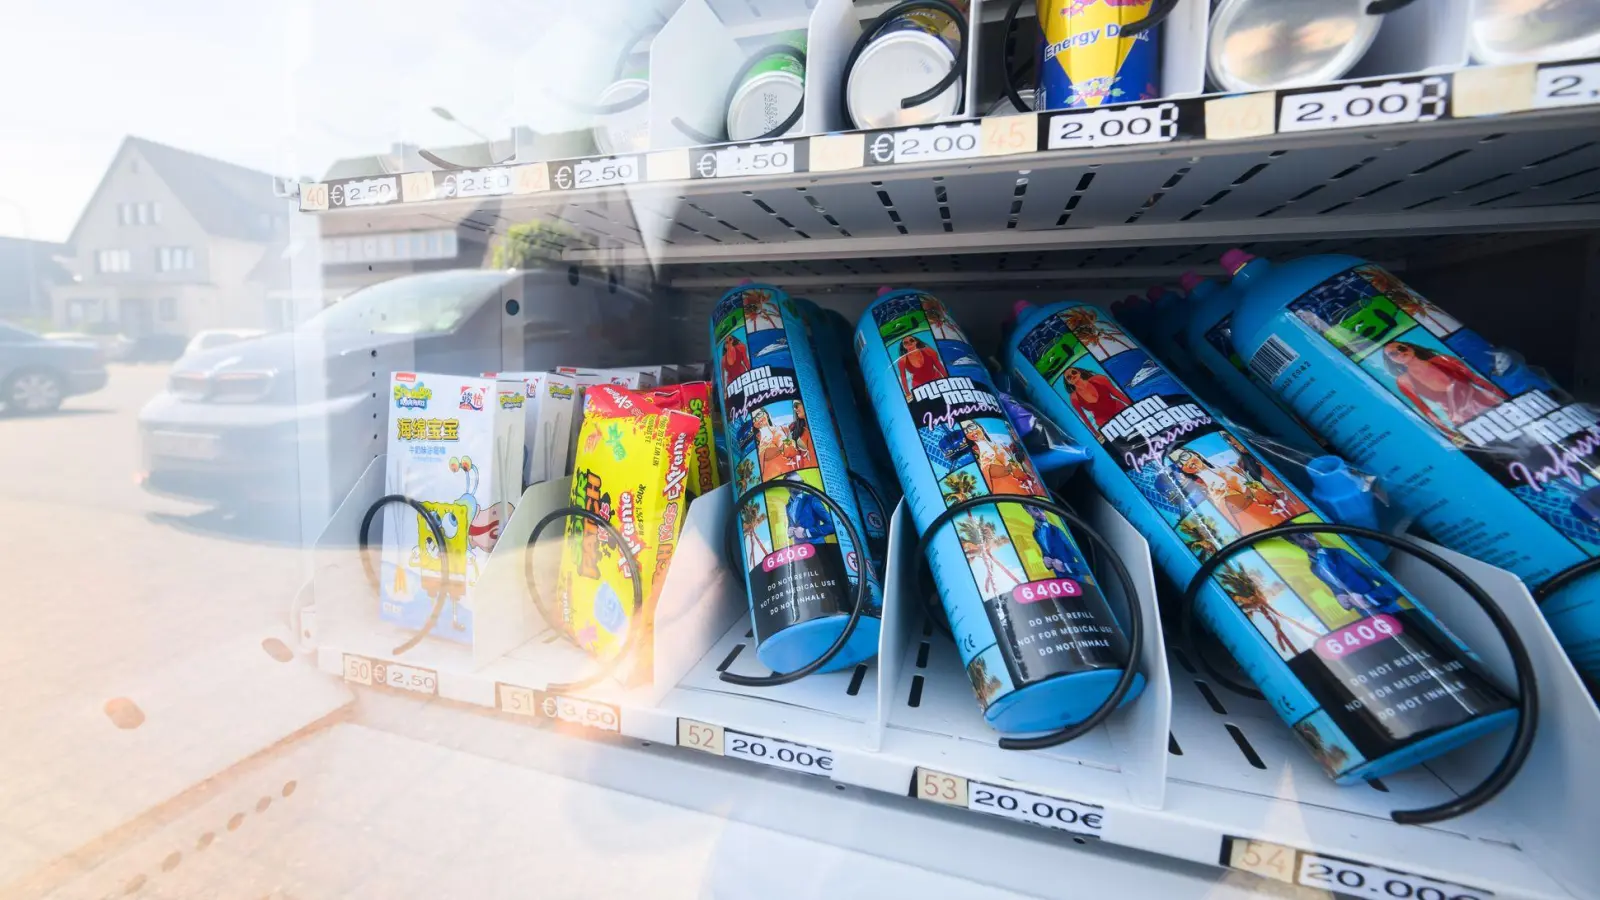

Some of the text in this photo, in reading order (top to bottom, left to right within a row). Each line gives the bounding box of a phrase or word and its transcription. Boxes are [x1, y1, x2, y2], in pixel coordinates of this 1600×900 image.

[1044, 28, 1100, 62] Energy
[1295, 94, 1408, 122] 2,00
[990, 119, 1025, 149] 45
[1060, 117, 1152, 140] 2,00
[901, 134, 976, 156] 2.00
[733, 152, 788, 171] .50
[462, 170, 510, 192] 2.50
[578, 163, 634, 185] 2.50
[306, 187, 325, 207] 40
[350, 183, 391, 203] 2.50
[730, 385, 797, 423] Infusions
[397, 418, 459, 441] 海绵宝宝
[1124, 414, 1212, 474] Infusions
[695, 445, 712, 489] PATC
[635, 484, 646, 504] SOUR
[767, 547, 808, 567] 640G
[760, 599, 770, 609] NOT
[772, 592, 784, 601] FOR
[822, 580, 836, 588] USE
[767, 583, 776, 592] DO
[778, 577, 792, 587] NOT
[1021, 582, 1075, 600] 640G
[770, 607, 779, 615] DO
[780, 601, 795, 610] NOT
[1029, 617, 1042, 627] DO
[1045, 614, 1064, 623] NOT
[1017, 635, 1035, 647] NOT
[1039, 630, 1058, 641] FOR
[1325, 618, 1393, 656] 640G
[1039, 647, 1053, 657] DO
[1056, 643, 1075, 652] NOT
[350, 661, 368, 680] 50
[1350, 675, 1367, 687] DO
[1369, 663, 1393, 679] NOT
[1344, 696, 1364, 713] NOT
[1370, 686, 1393, 703] FOR
[1443, 659, 1464, 672] USE
[510, 692, 532, 711] 51
[1378, 706, 1395, 720] DO
[1399, 695, 1422, 712] NOT
[688, 726, 715, 748] 52
[732, 738, 833, 770] 20.00€
[924, 778, 957, 800] 53
[975, 790, 1102, 829] 20.00€
[1241, 843, 1287, 873] 54
[1307, 863, 1480, 900] 20.00
